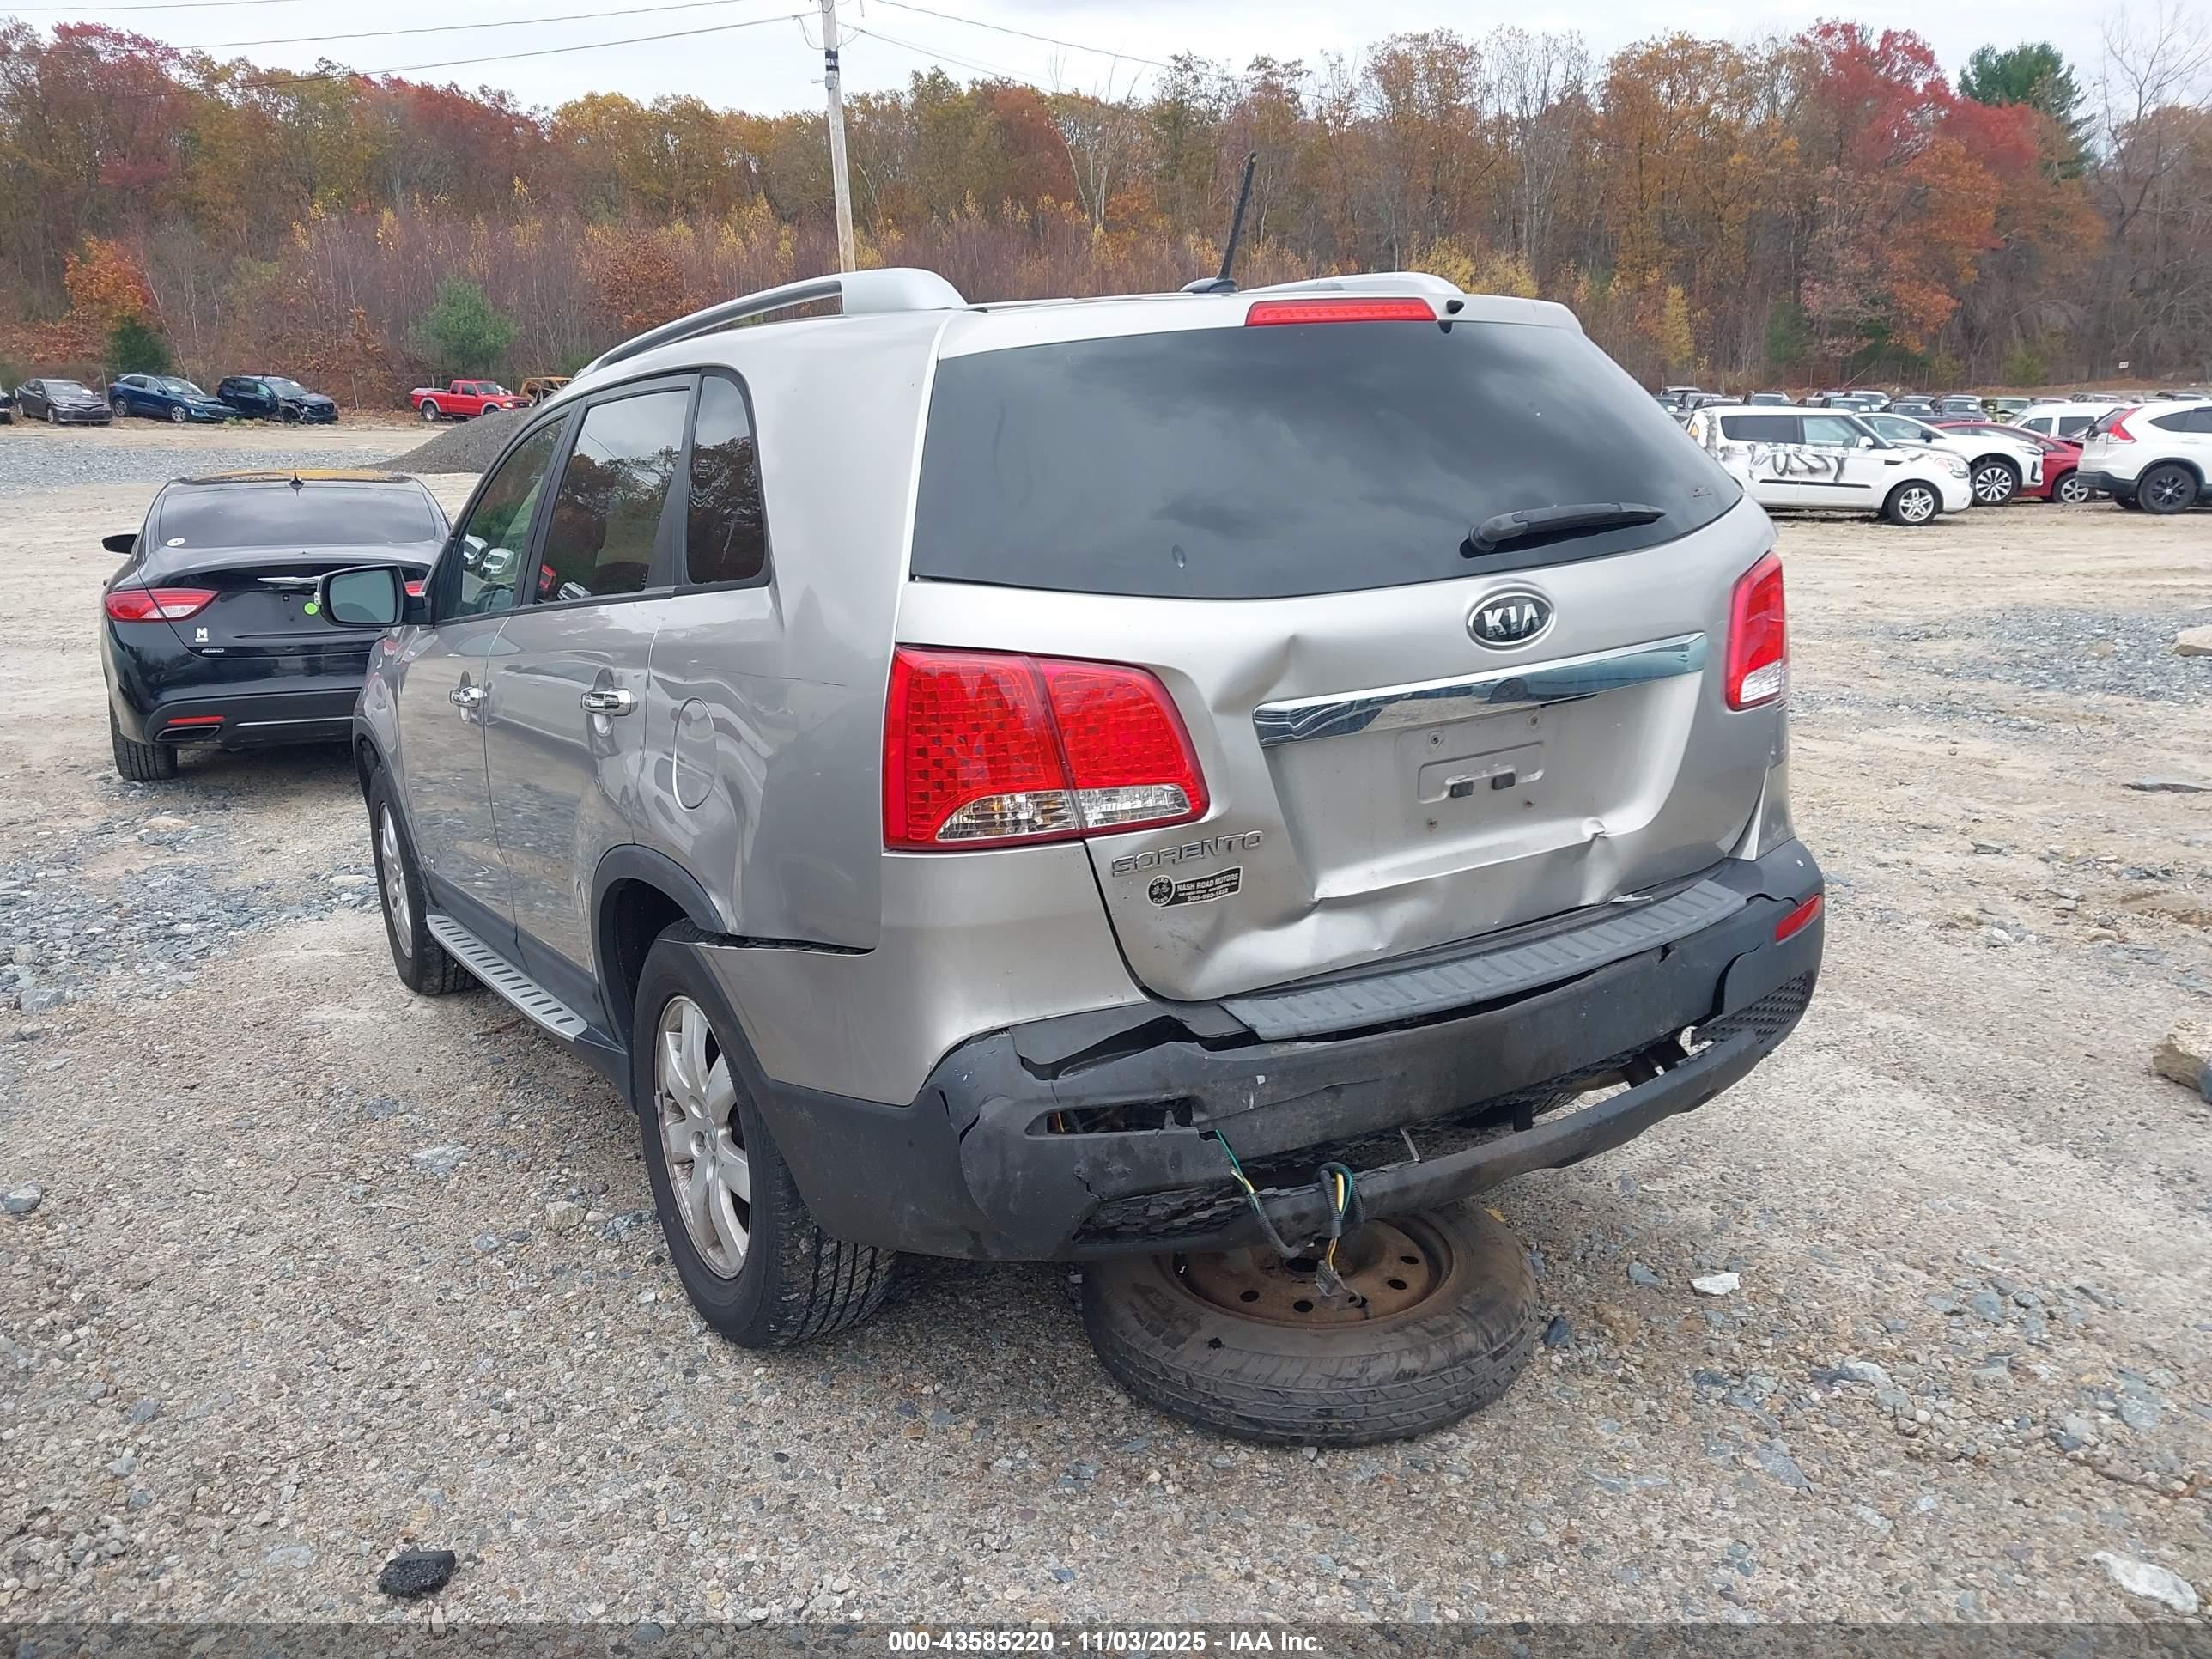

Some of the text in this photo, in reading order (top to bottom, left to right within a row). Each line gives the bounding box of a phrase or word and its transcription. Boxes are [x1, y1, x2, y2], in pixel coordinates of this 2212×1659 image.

[1483, 603, 1542, 638] KIA
[1112, 830, 1265, 877] SORENTO
[1177, 883, 1195, 892] NASH
[1196, 879, 1214, 889] ROAD
[1215, 873, 1238, 885] MOTORS
